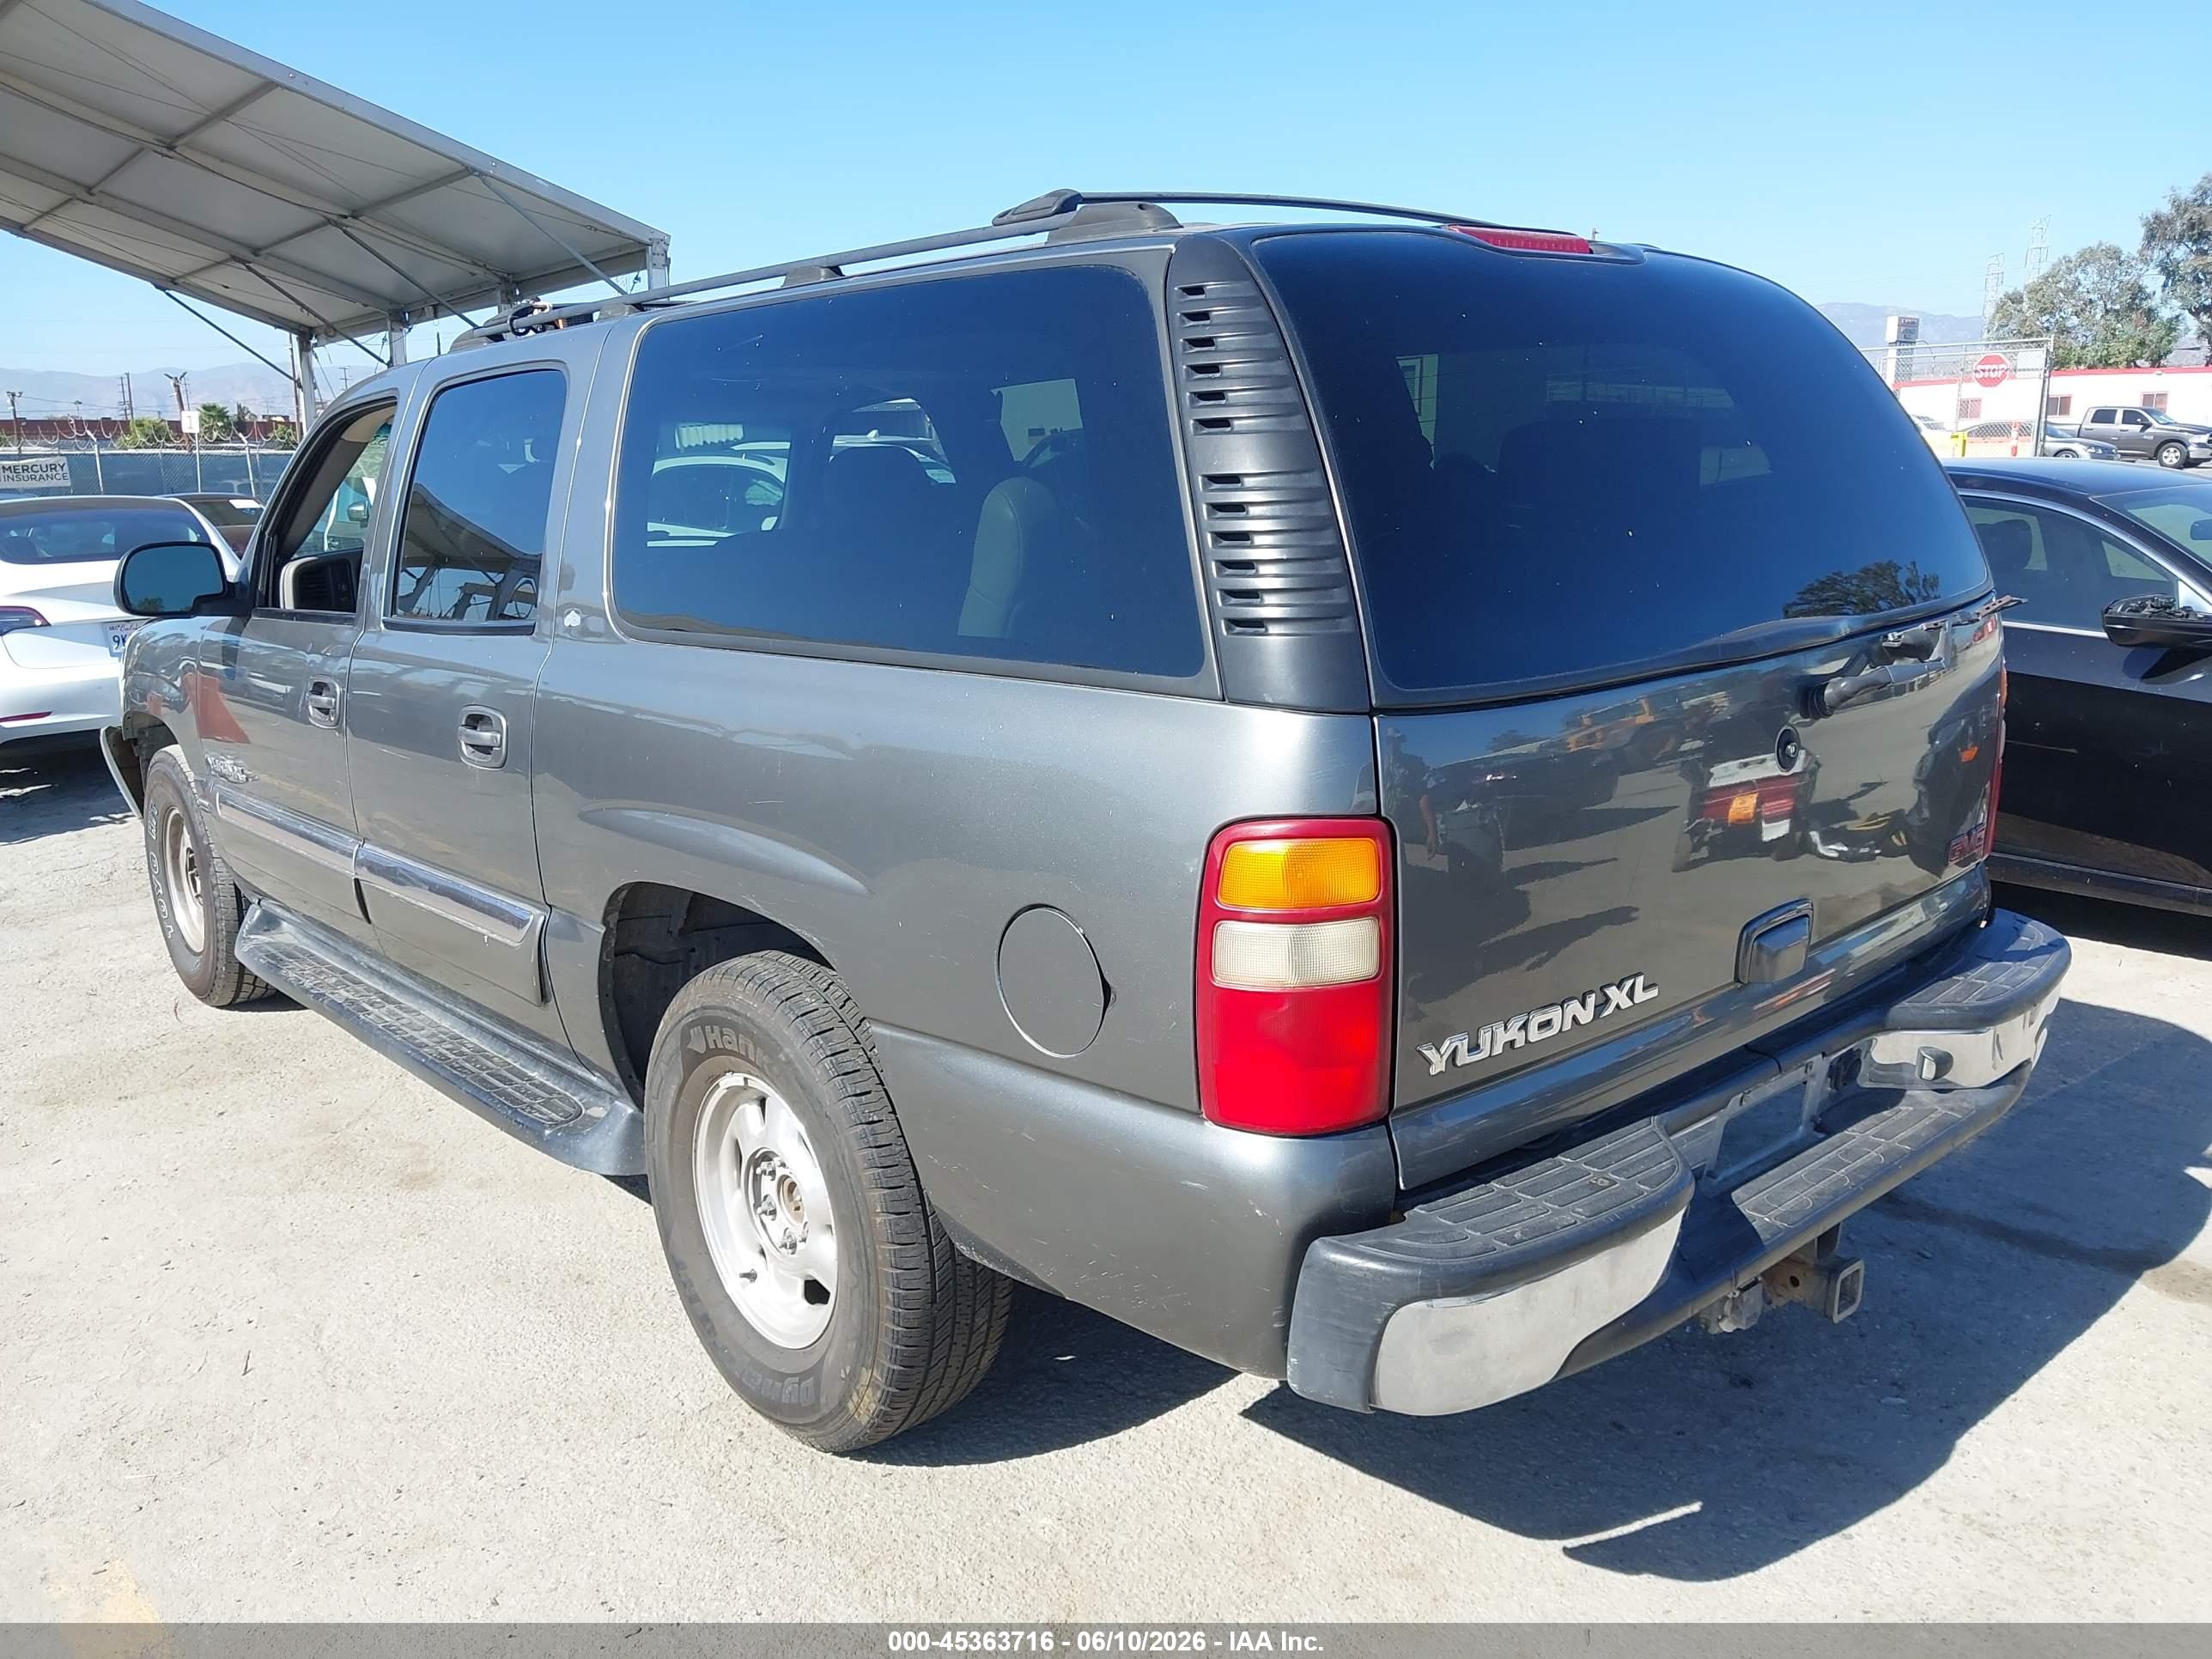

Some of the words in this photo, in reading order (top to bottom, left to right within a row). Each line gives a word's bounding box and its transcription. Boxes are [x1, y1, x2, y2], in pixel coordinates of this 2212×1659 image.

[1976, 363, 2007, 378] STOP
[2, 463, 65, 473] MERCURY
[3, 472, 70, 482] INSURANCE
[1417, 989, 1596, 1076] YUKON
[1598, 971, 1659, 1018] XL
